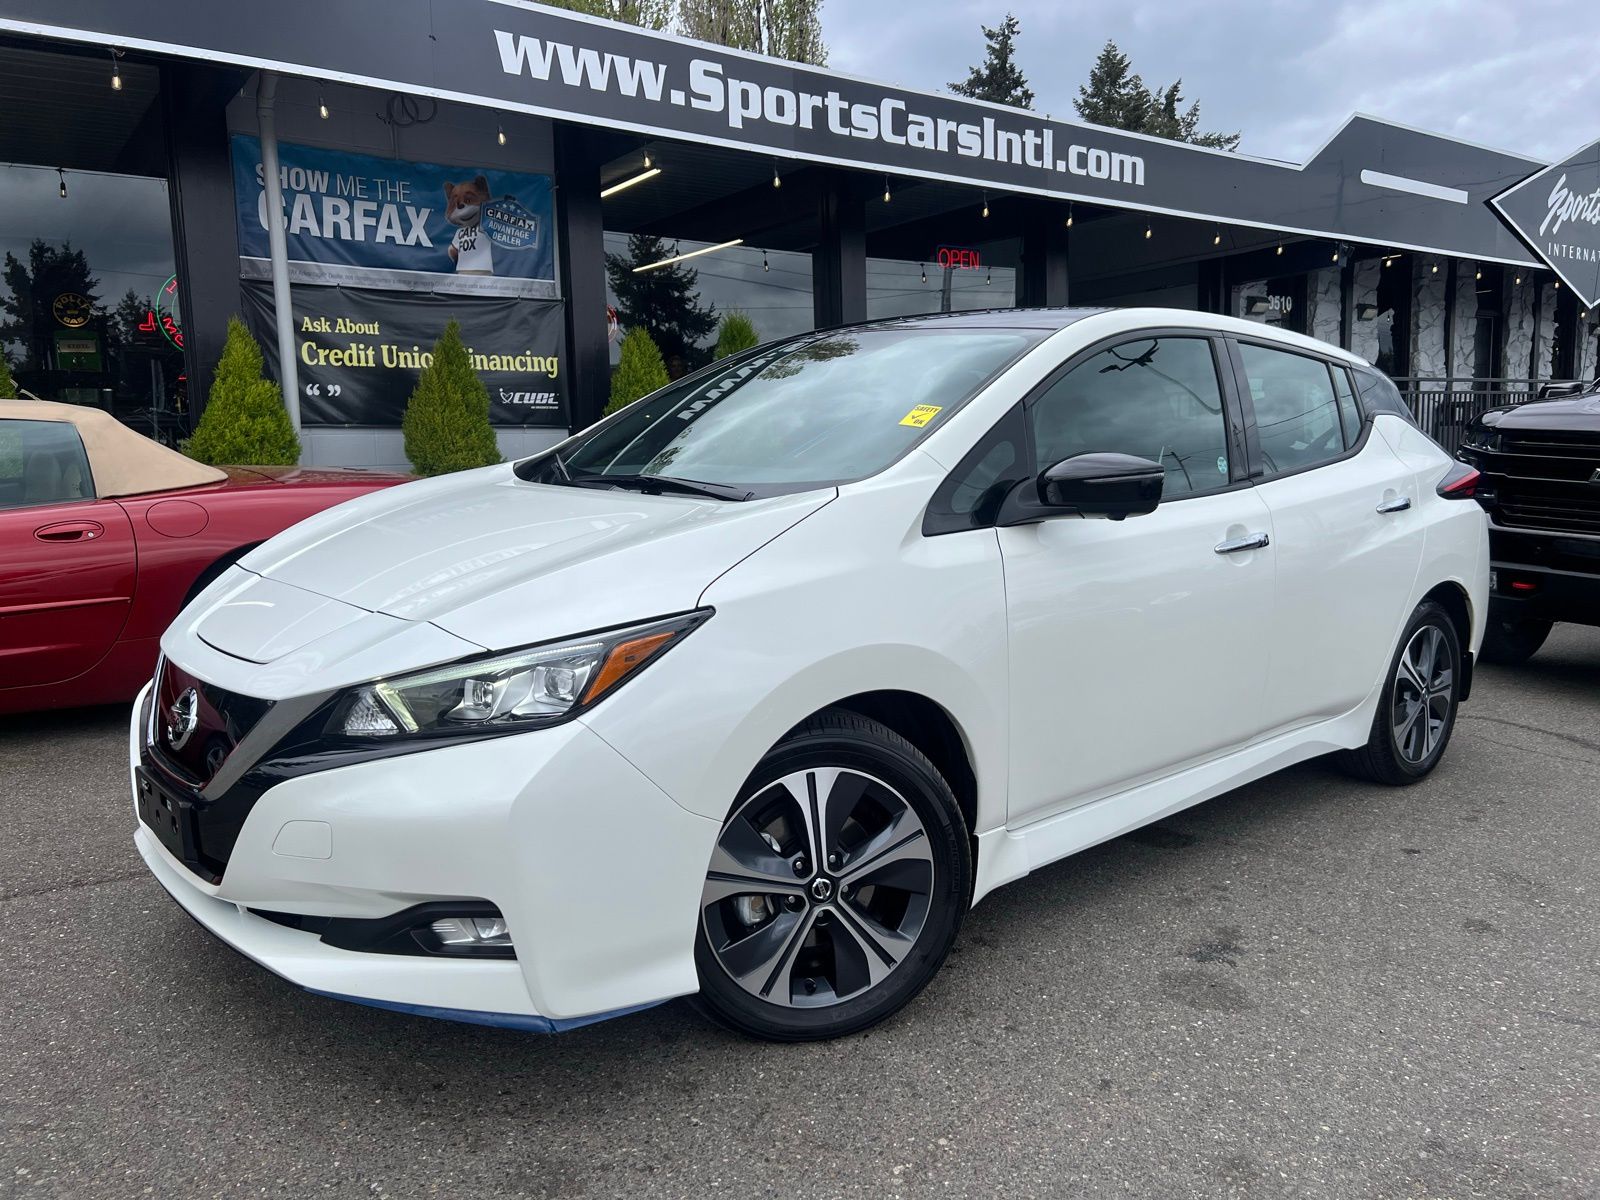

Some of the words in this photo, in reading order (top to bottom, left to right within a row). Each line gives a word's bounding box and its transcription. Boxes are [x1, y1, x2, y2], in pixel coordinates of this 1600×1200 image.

[493, 29, 1145, 186] www.SportsCarsIntl.com
[336, 173, 368, 199] ME
[373, 179, 411, 204] THE
[486, 208, 535, 231] CARFAX
[458, 226, 478, 239] CAR
[488, 220, 530, 240] ADVANTAGE
[492, 231, 521, 247] DEALER
[459, 238, 476, 252] FOX
[938, 248, 980, 271] OPEN
[301, 317, 331, 333] Ask
[334, 318, 380, 336] About
[301, 341, 376, 368] Credit
[380, 345, 435, 369] Unio
[465, 347, 559, 379] inancing
[513, 391, 559, 405] CUDL
